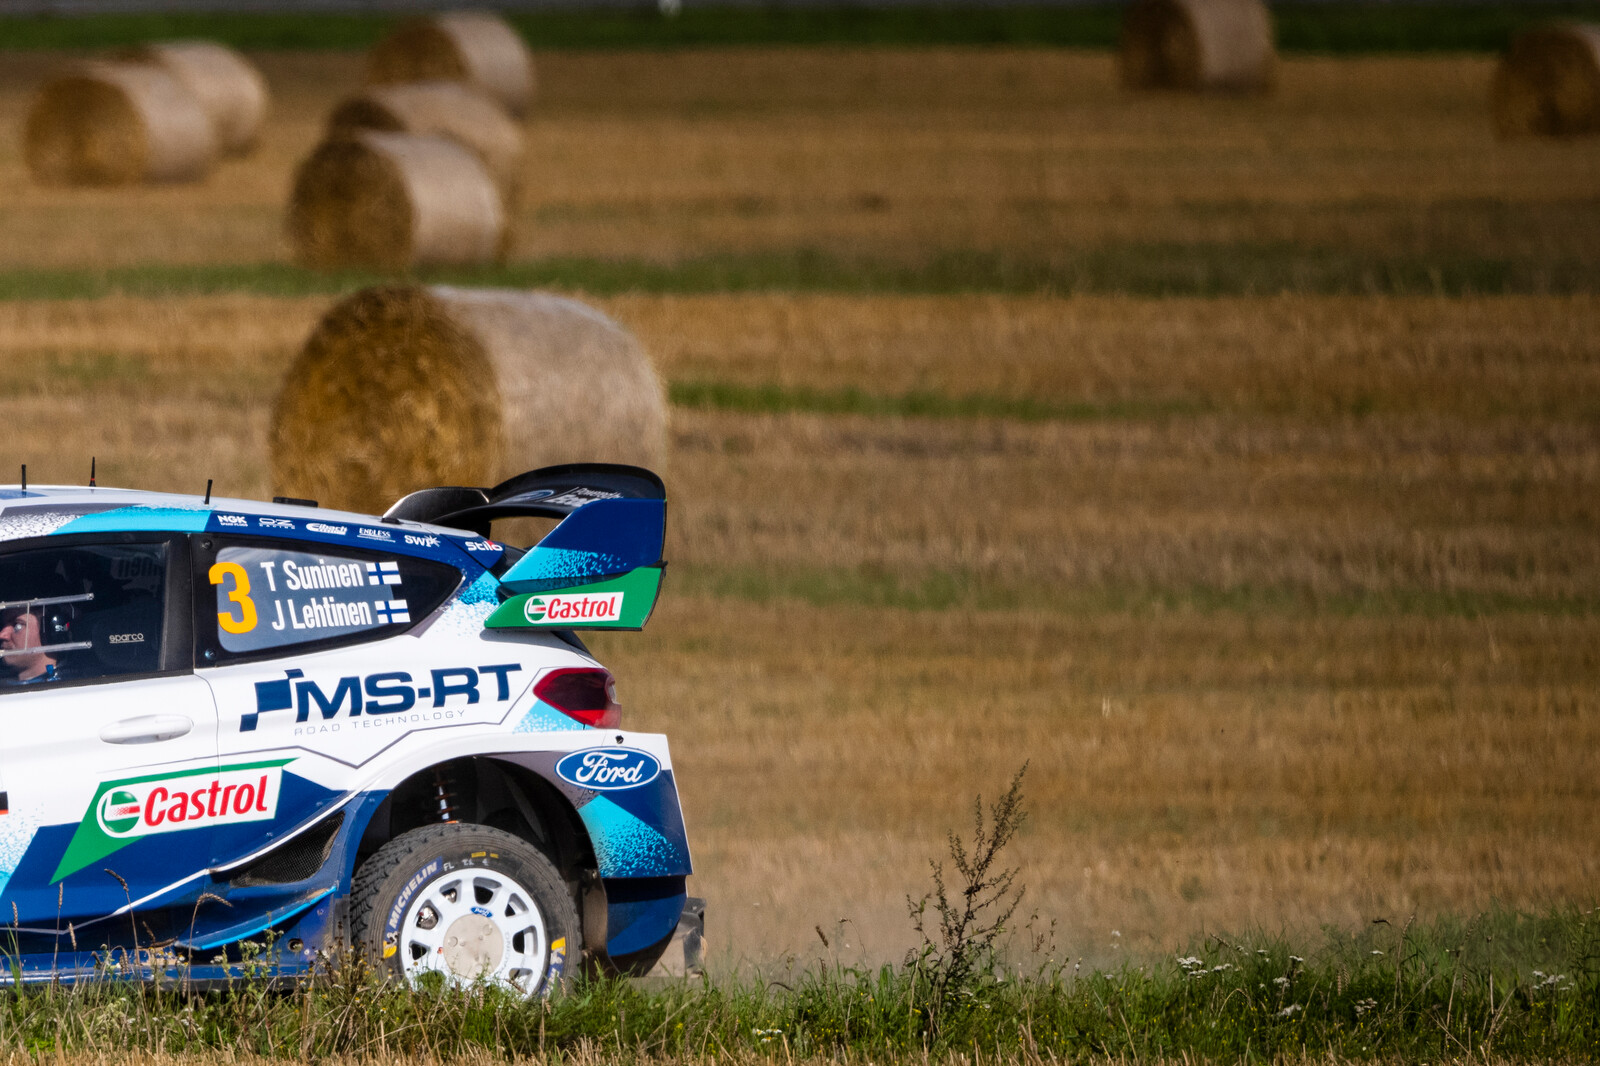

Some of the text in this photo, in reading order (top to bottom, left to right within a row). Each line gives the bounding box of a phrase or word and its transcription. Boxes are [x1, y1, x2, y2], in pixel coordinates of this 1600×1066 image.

[217, 515, 247, 524] NGK
[359, 527, 391, 538] ENDLESS
[465, 540, 503, 551] Stilo
[260, 560, 365, 592] T Suninen
[207, 561, 259, 635] 3
[271, 597, 372, 631] J Lehtinen
[547, 596, 616, 619] Castrol
[109, 632, 144, 643] sparco
[295, 663, 523, 723] MS-RT
[294, 710, 466, 737] ROAD TECHNOLOGY
[575, 751, 645, 783] Ford
[143, 774, 268, 827] Castrol
[389, 861, 438, 929] MICHELIN
